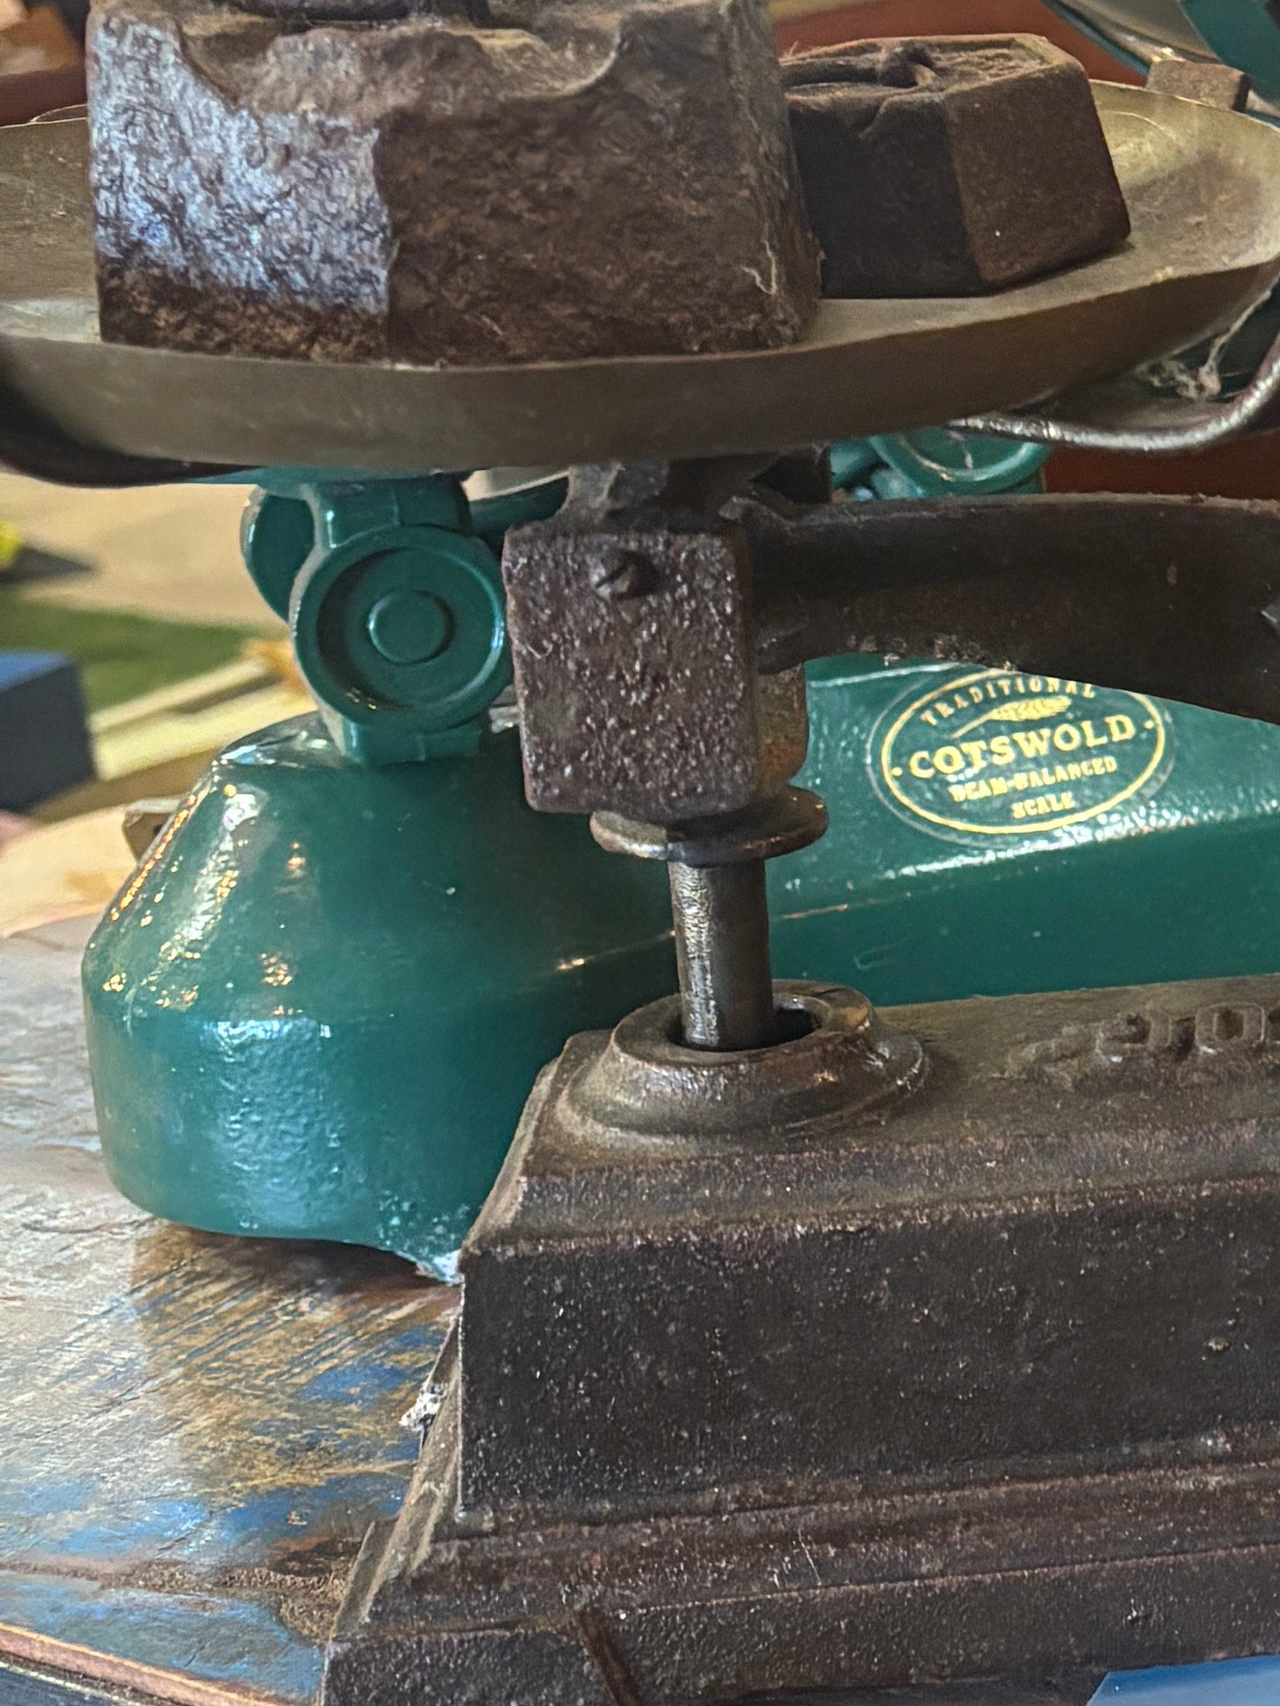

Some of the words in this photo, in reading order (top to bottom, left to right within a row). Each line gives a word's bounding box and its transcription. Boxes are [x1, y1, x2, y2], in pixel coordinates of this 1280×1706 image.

[920, 676, 1096, 726] TRADITIONAL
[909, 714, 1136, 779] COTSWOLD
[948, 755, 1118, 803] BEAM-BALANCED
[1010, 791, 1076, 820] SCALE
